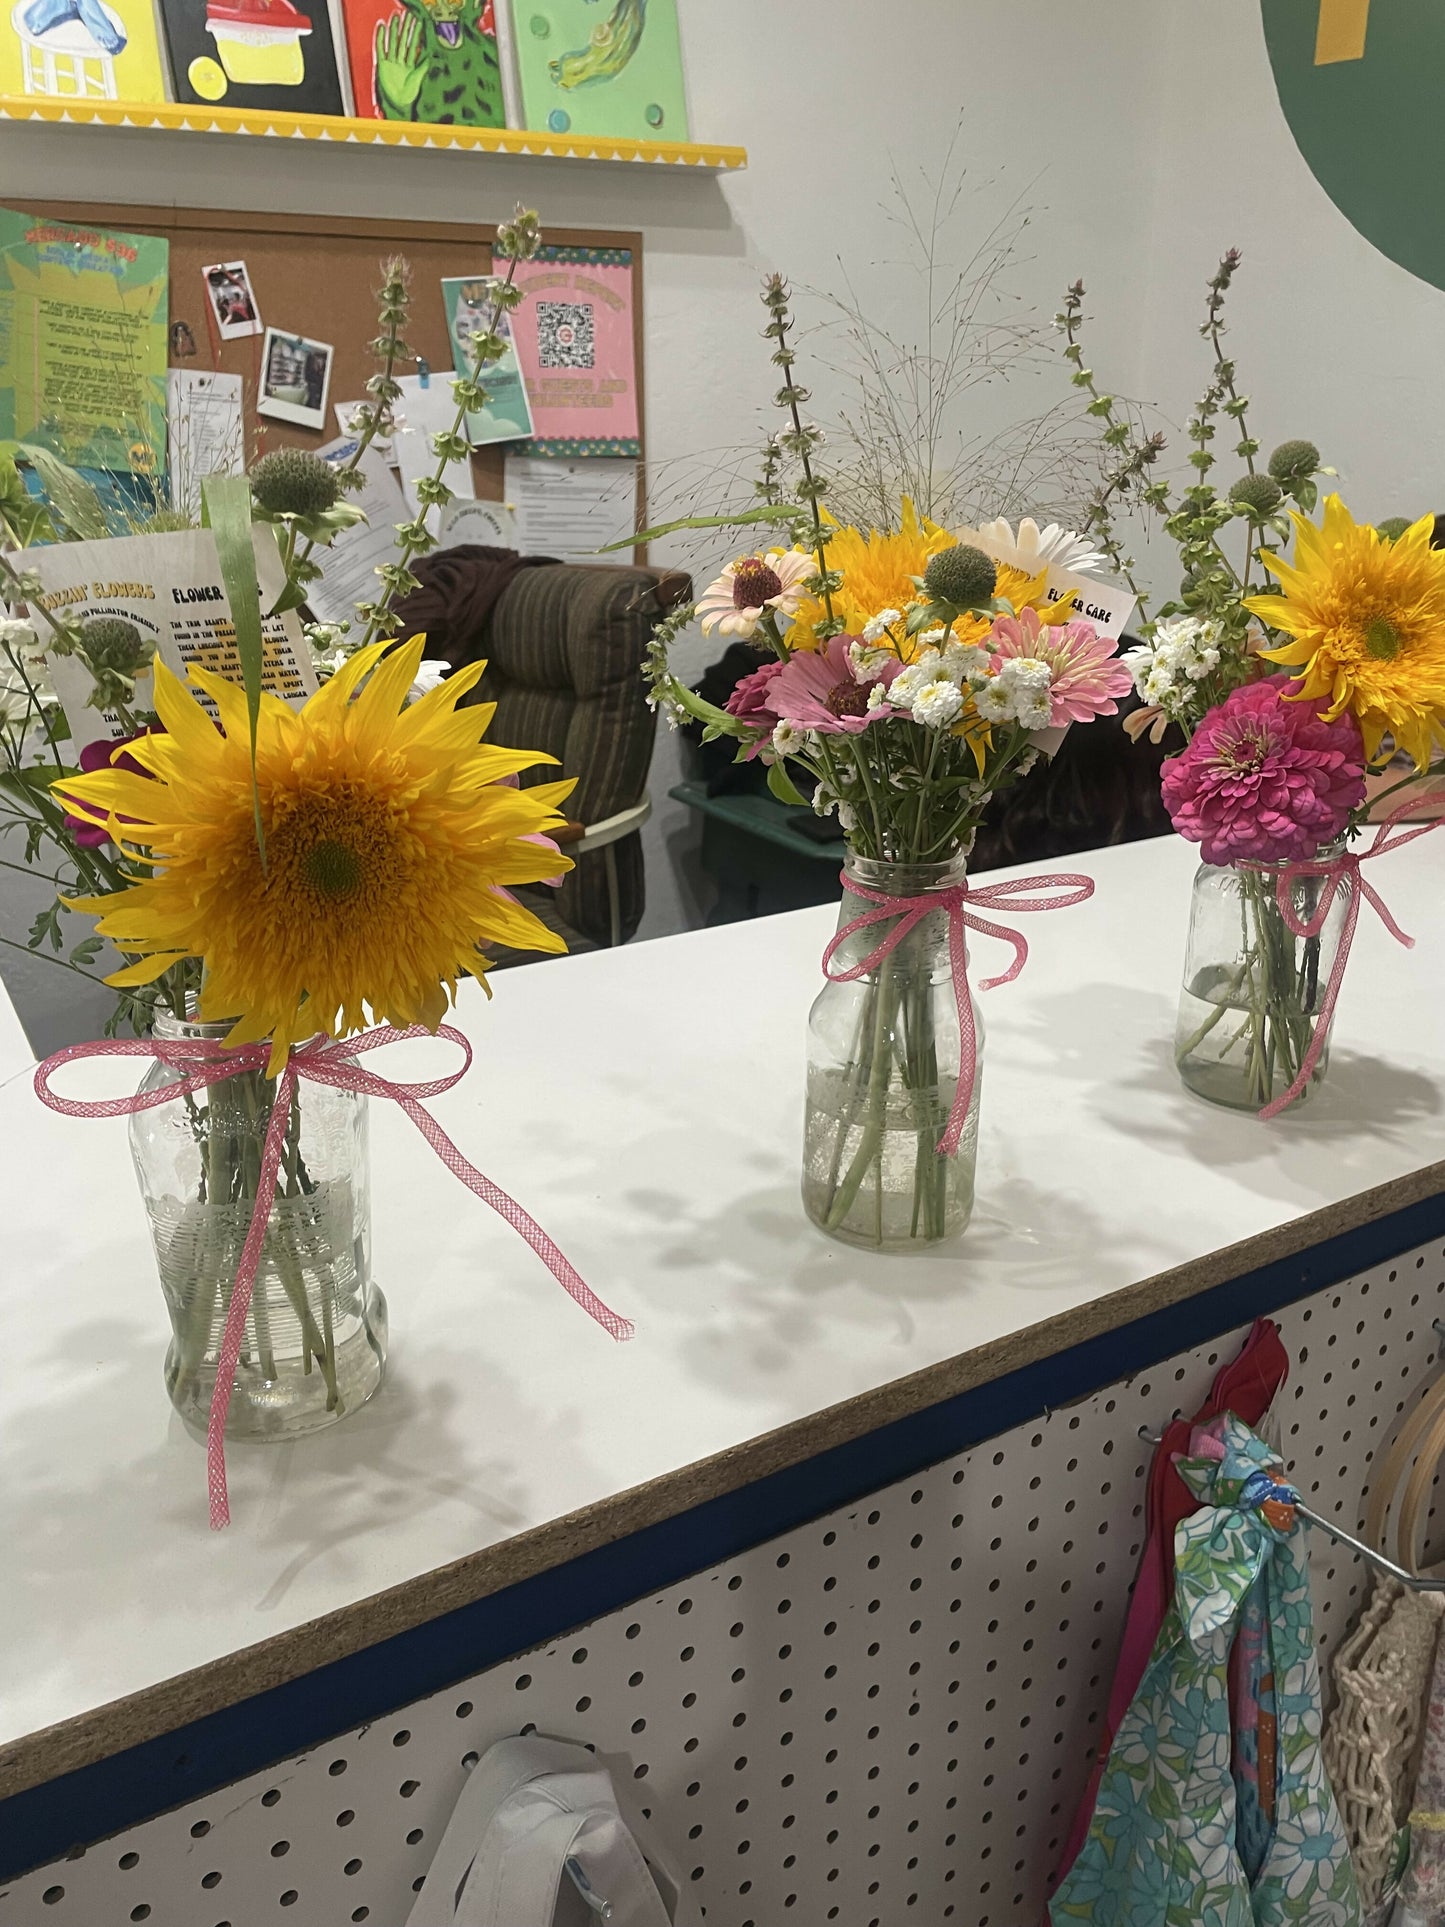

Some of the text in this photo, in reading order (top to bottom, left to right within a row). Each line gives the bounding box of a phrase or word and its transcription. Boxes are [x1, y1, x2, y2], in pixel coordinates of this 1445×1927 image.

[92, 582, 155, 600] FLOWERS
[172, 585, 224, 604] FLOWER
[91, 607, 129, 618] POLLINATOR
[1048, 588, 1112, 623] FLER CARE
